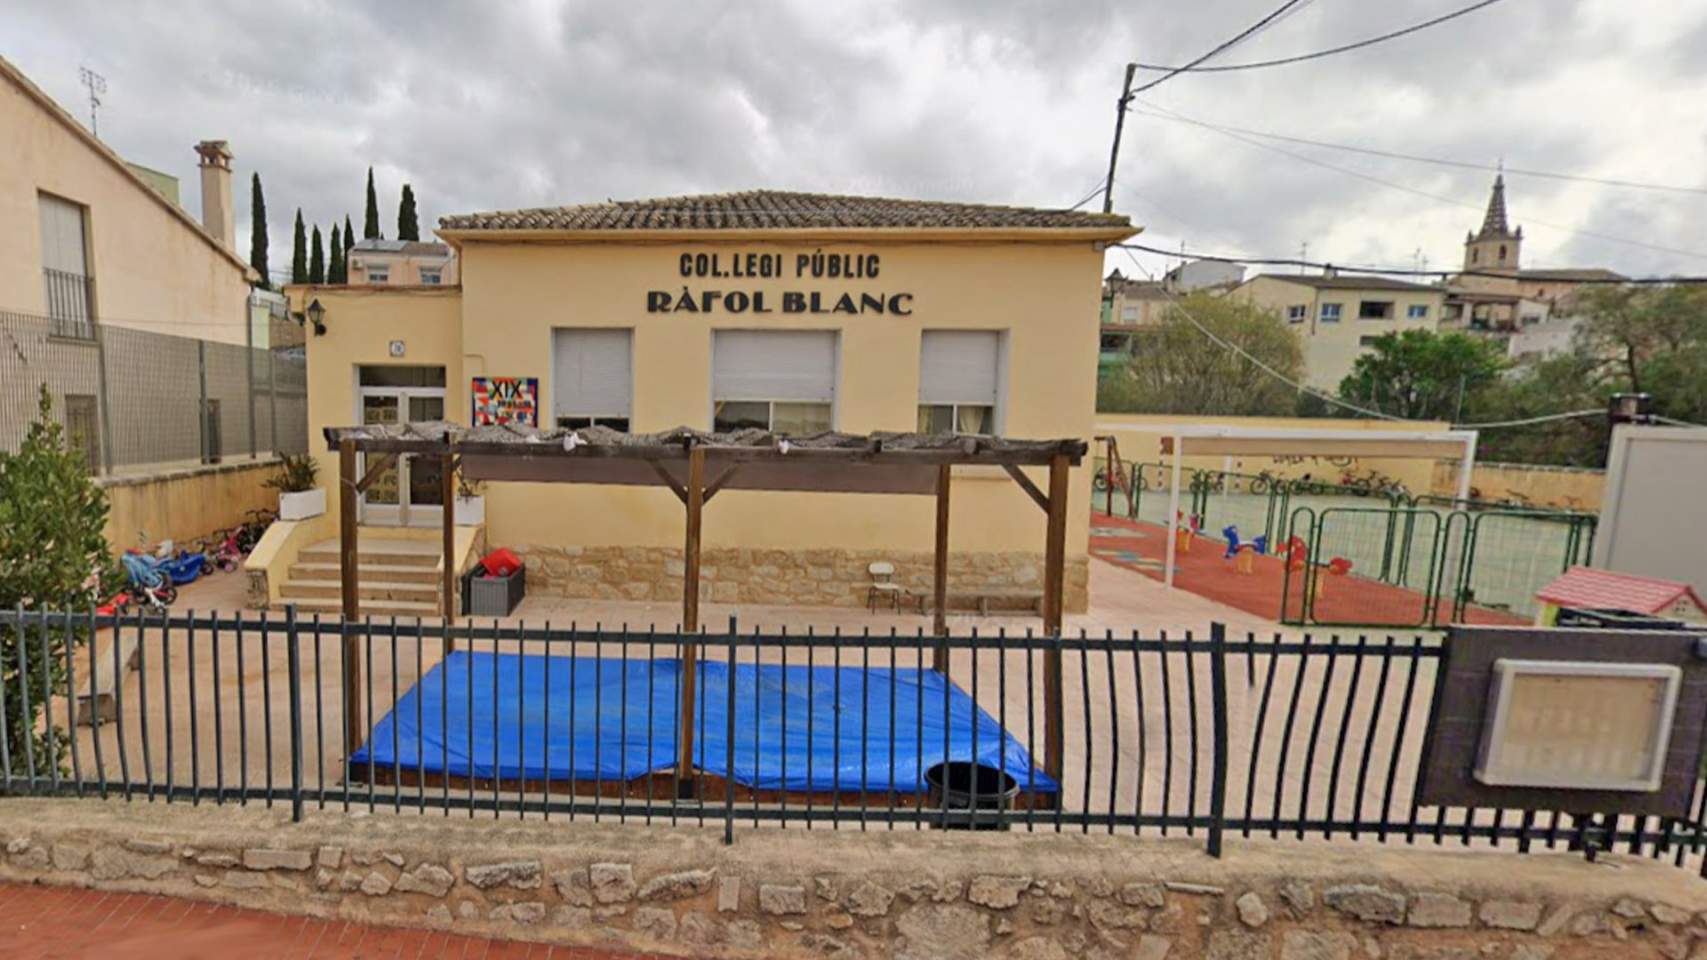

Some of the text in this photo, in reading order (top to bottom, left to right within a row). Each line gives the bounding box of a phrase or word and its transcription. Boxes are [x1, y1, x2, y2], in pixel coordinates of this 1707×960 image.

[680, 248, 880, 278] COL.LEGI PÚBLIC
[647, 286, 914, 315] RÀFOL BLANC
[492, 380, 523, 398] XIX
